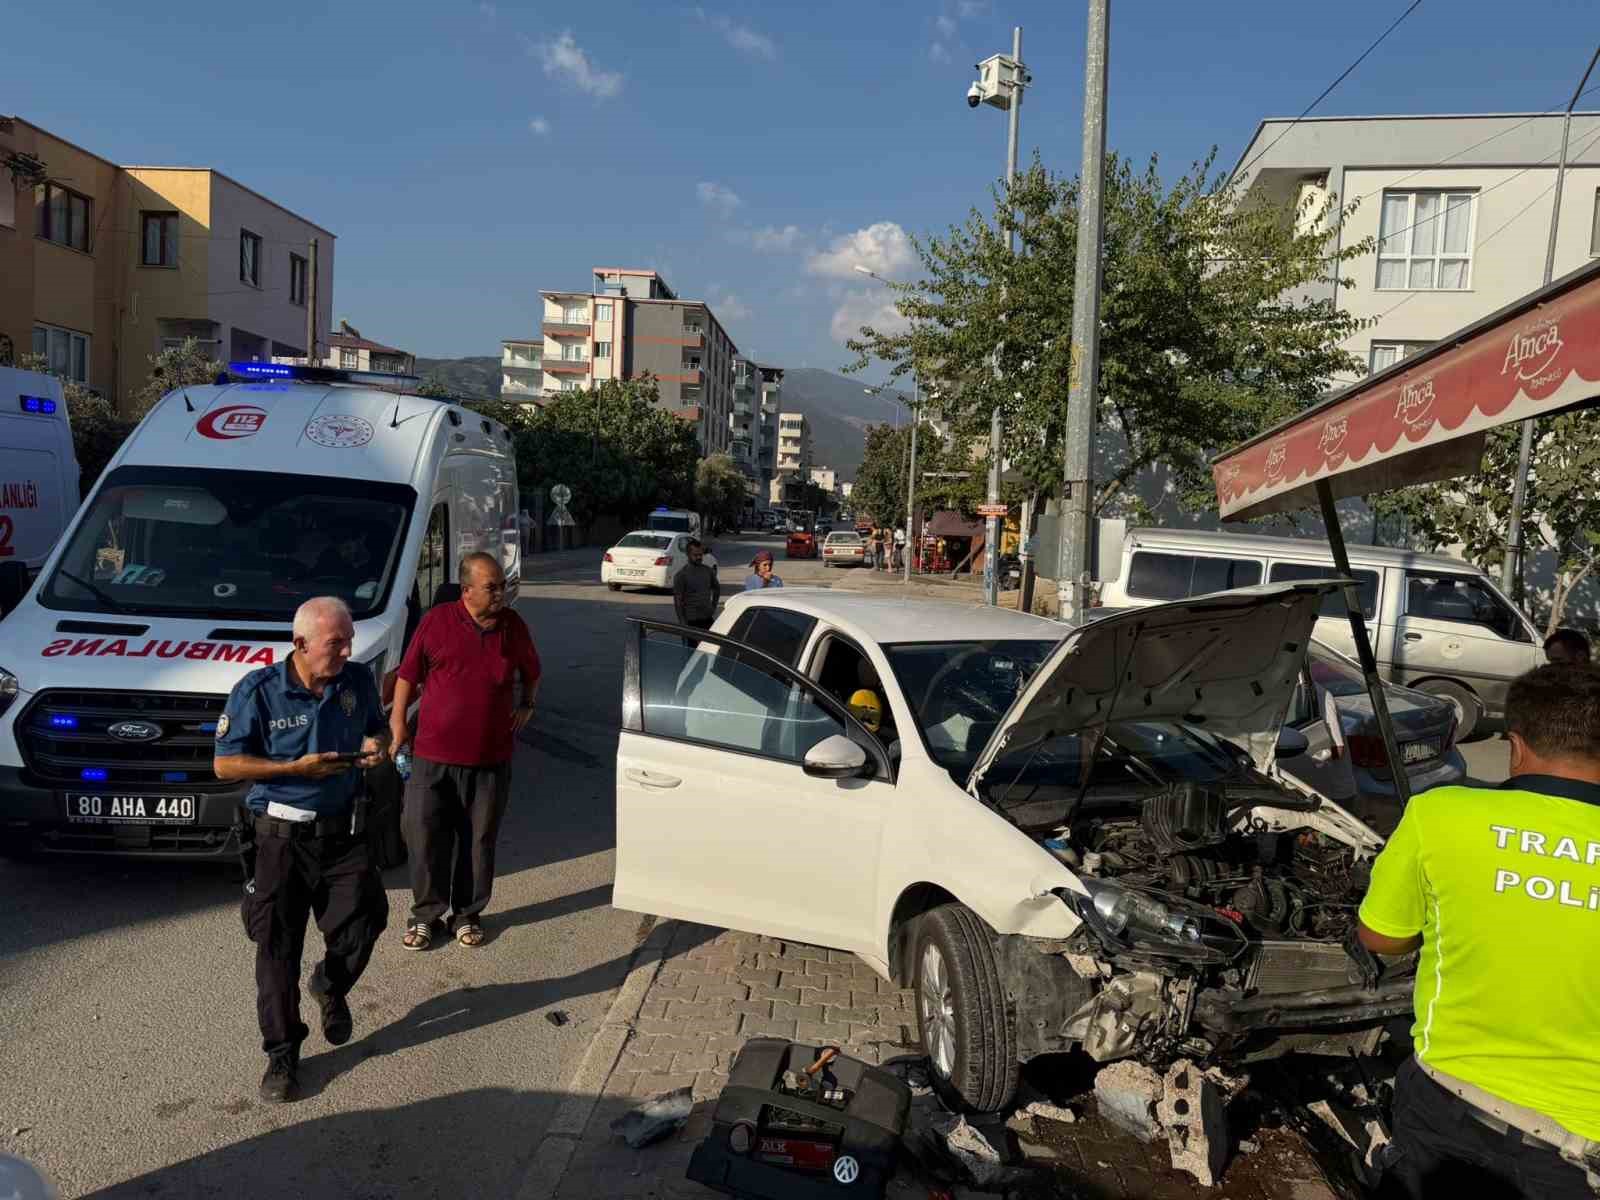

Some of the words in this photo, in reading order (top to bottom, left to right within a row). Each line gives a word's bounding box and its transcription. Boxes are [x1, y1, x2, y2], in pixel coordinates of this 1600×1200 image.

[233, 414, 258, 424] 112
[0, 480, 38, 509] ANLIĞI
[79, 796, 102, 816] 80
[111, 797, 146, 817] AHA
[155, 798, 192, 817] 440
[1495, 869, 1600, 911] POLİ
